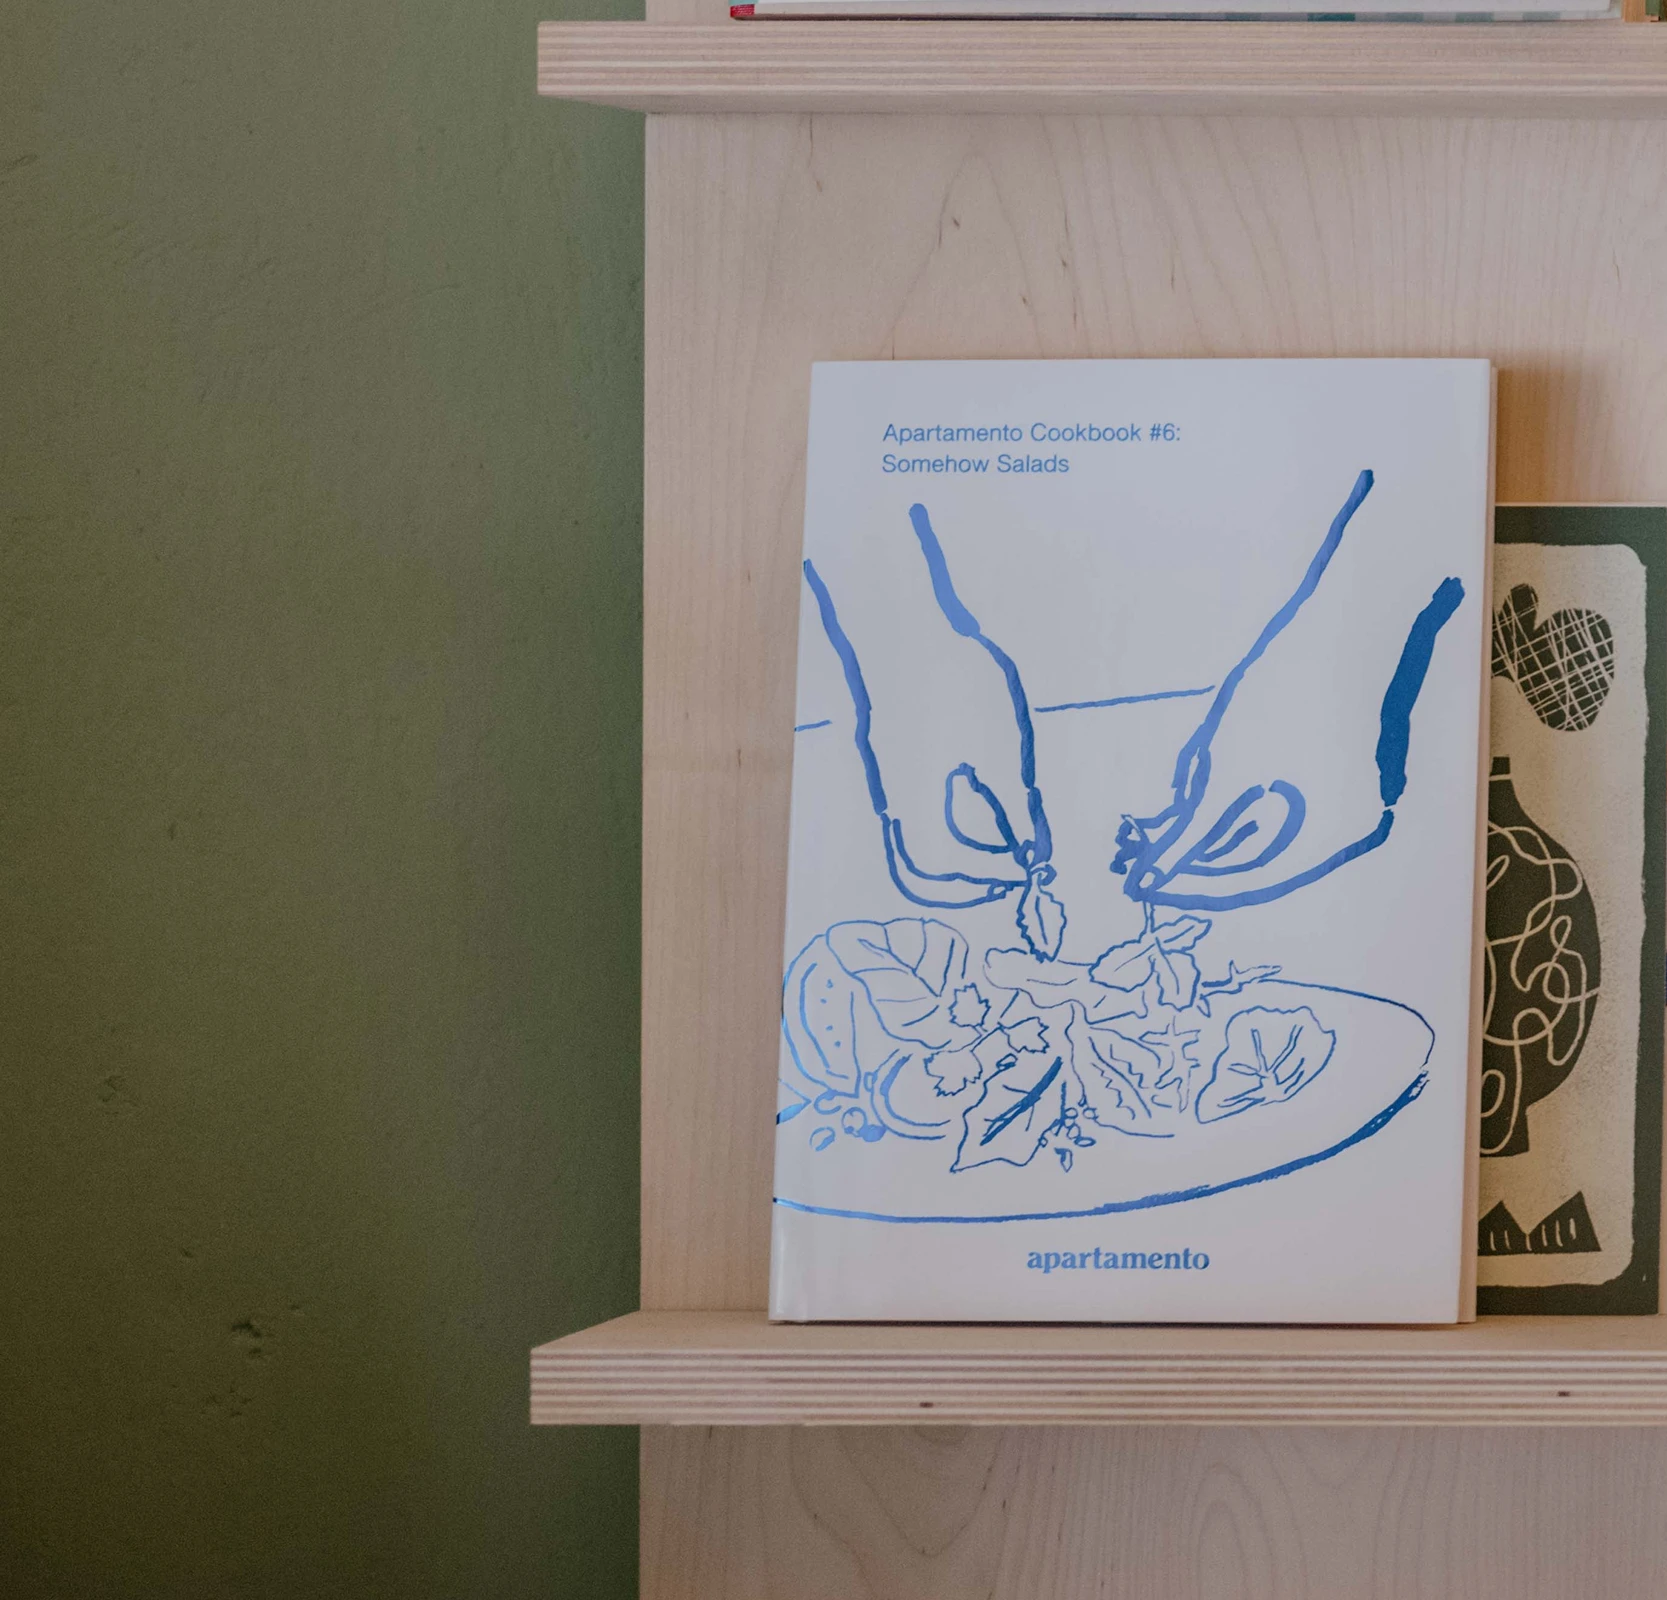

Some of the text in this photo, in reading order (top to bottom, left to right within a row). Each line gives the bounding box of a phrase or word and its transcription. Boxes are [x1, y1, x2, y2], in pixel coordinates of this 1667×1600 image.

[882, 422, 1181, 446] Apartamento Cookbook #6:
[881, 453, 1070, 474] Somehow Salads
[1026, 1246, 1210, 1275] apartamento
